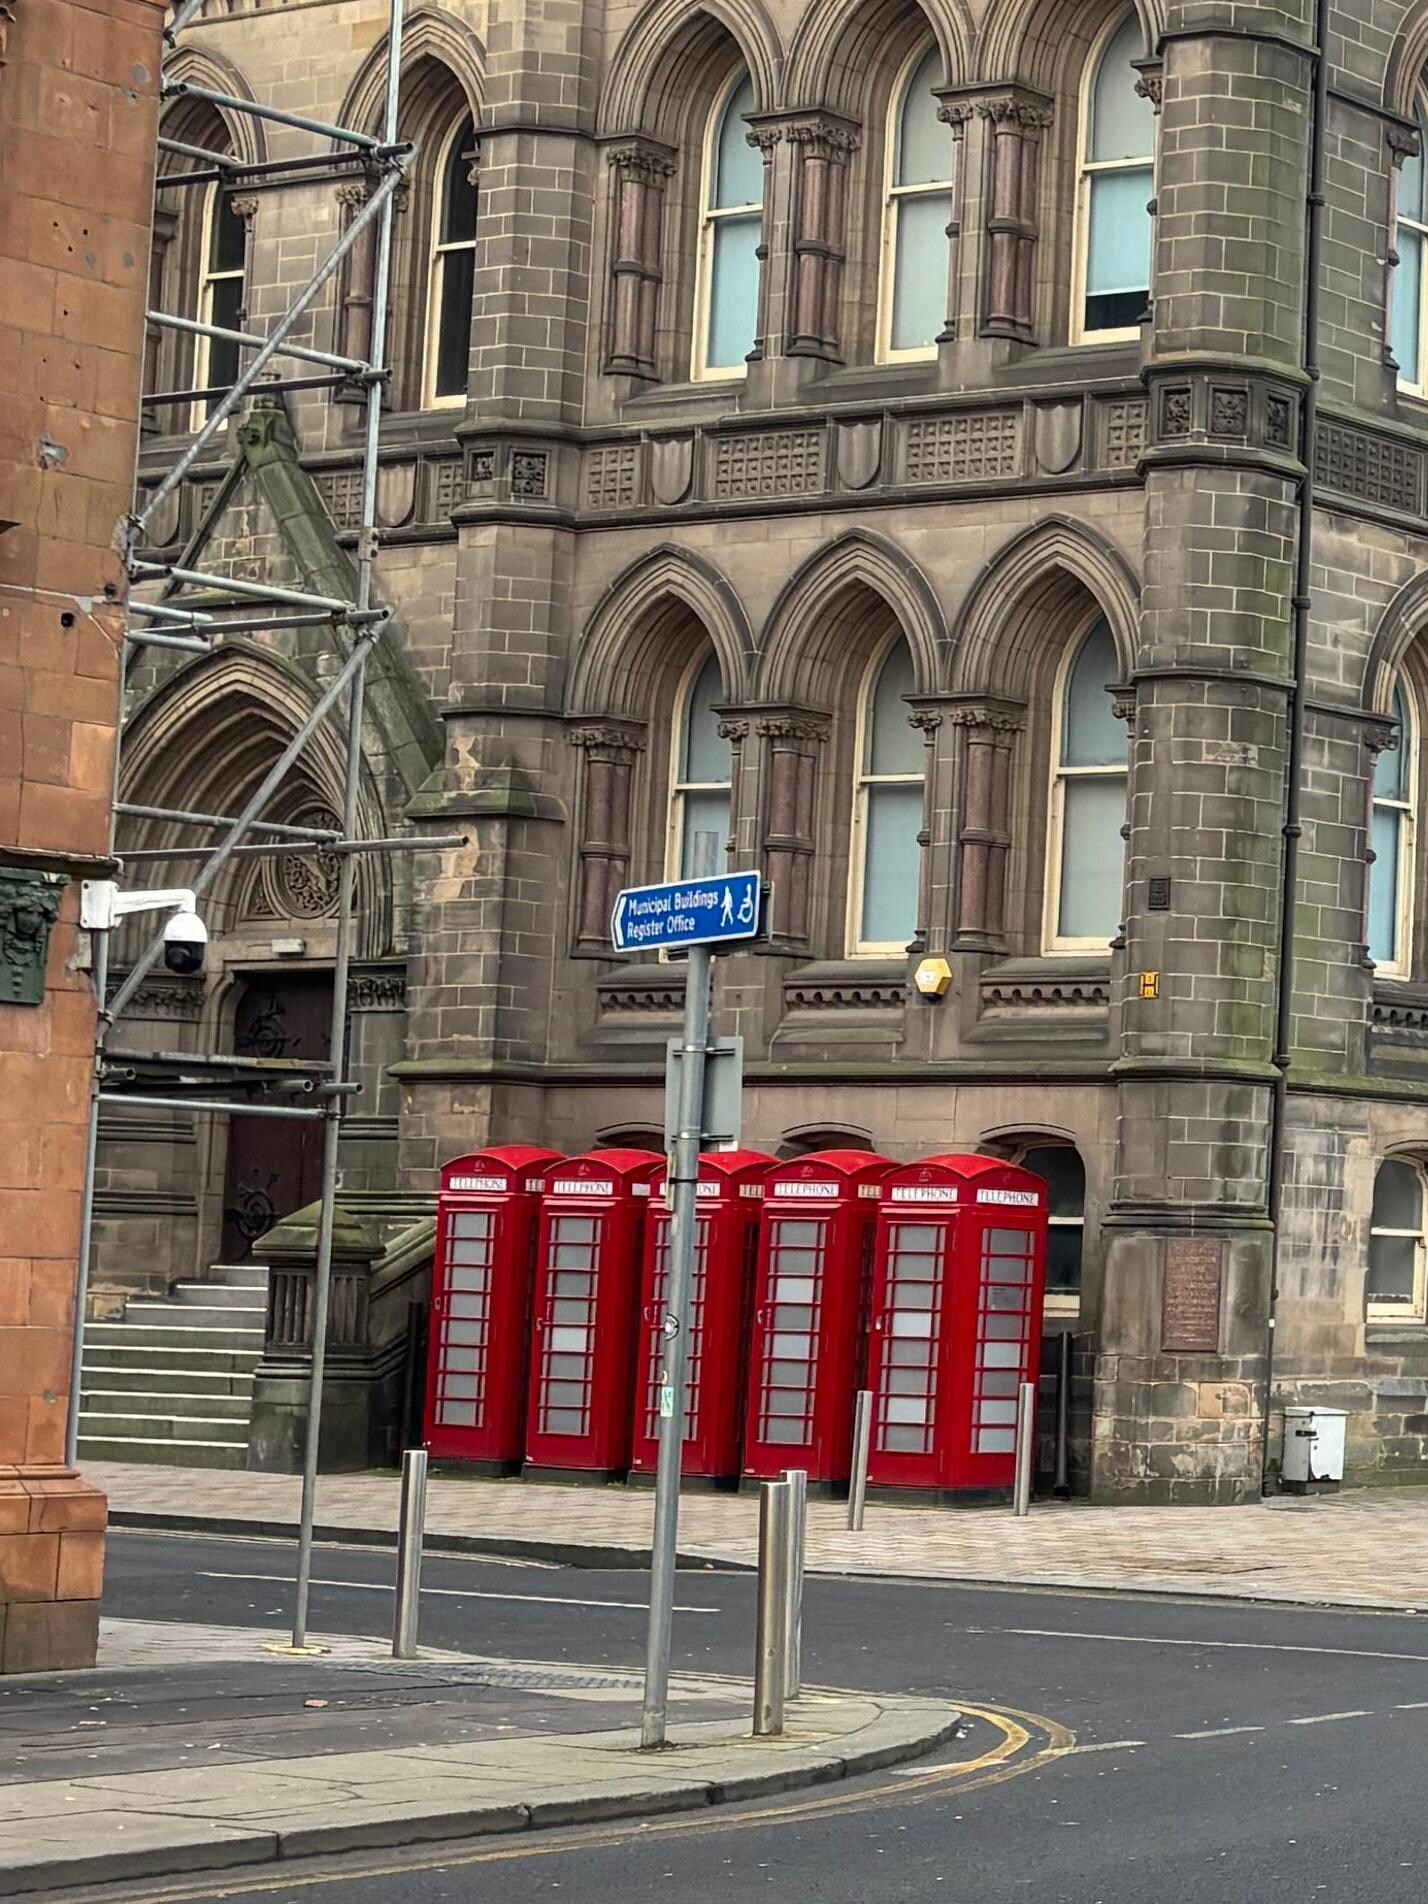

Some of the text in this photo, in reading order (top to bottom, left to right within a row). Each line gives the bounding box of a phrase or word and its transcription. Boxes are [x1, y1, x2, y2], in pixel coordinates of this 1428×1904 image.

[628, 889, 719, 917] Municipal Buildings
[627, 914, 696, 941] Register Office
[452, 1177, 505, 1191] TELEPHONE
[555, 1181, 611, 1194] TELEPHONE
[777, 1183, 838, 1196] TELEPHONE
[894, 1187, 956, 1201] TELEPHONE
[980, 1189, 1037, 1205] TELEPHONE
